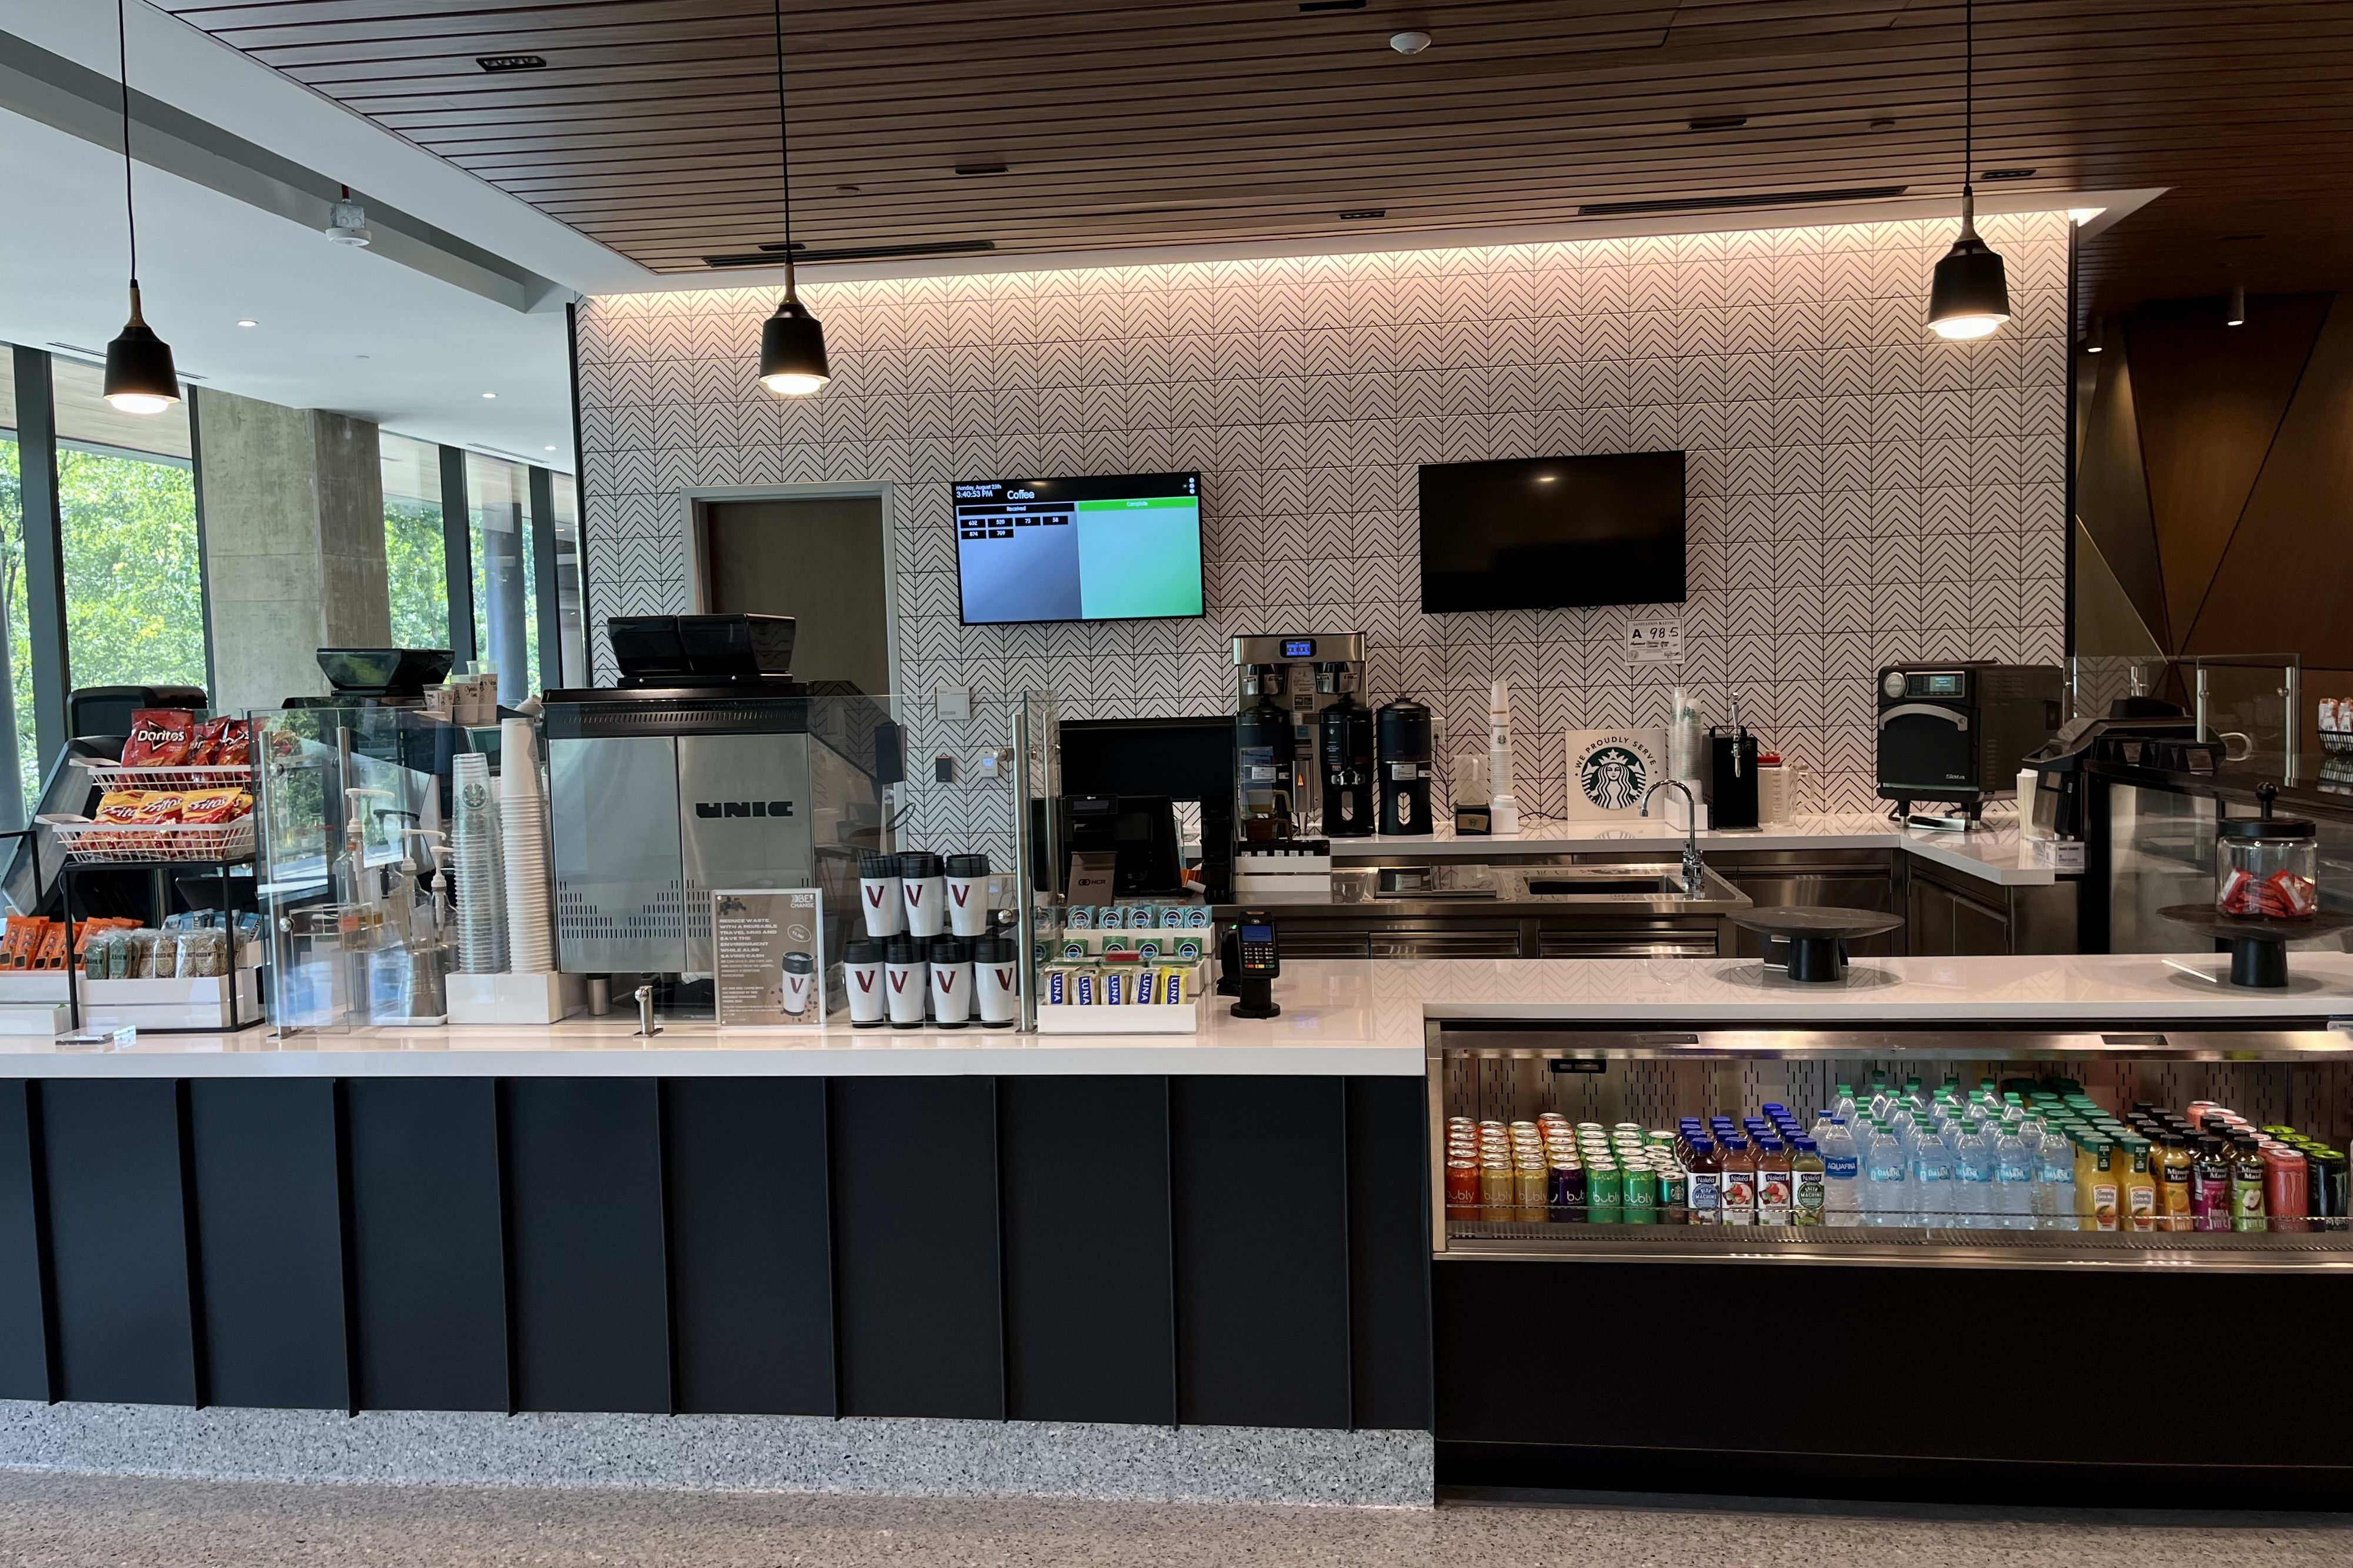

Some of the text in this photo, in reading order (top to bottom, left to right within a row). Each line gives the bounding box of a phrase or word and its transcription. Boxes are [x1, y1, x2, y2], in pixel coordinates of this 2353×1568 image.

[956, 489, 993, 498] 3:40:53 PM
[1006, 489, 1035, 499] Coffee
[1632, 629, 1642, 639] A
[1649, 627, 1679, 640] 98.5
[137, 729, 185, 742] Doritos
[1575, 736, 1657, 769] WE PROUDLY SERVE
[140, 796, 183, 812] Fritos
[188, 798, 227, 811] Fritos
[696, 801, 794, 818] UNIC
[865, 885, 885, 908] V
[905, 885, 922, 907] V
[951, 885, 970, 908] V
[789, 976, 804, 994] V
[855, 970, 875, 993] V
[889, 970, 908, 993] V
[936, 970, 956, 993] V
[994, 968, 1013, 990] V
[1081, 977, 1089, 1005] LUNA
[1141, 973, 1151, 1001] LUNA
[1170, 976, 1178, 1004] LUNA
[1827, 1162, 1855, 1170] AQUAFINA
[1877, 1169, 1901, 1177] DASANI
[1928, 1168, 1948, 1177] DASANI
[1955, 1168, 1978, 1177] DASANI
[2000, 1169, 2024, 1178] DASANI
[2044, 1170, 2068, 1179] DASANI
[1484, 1189, 1512, 1203] bubly
[1624, 1190, 1654, 1205] bubly
